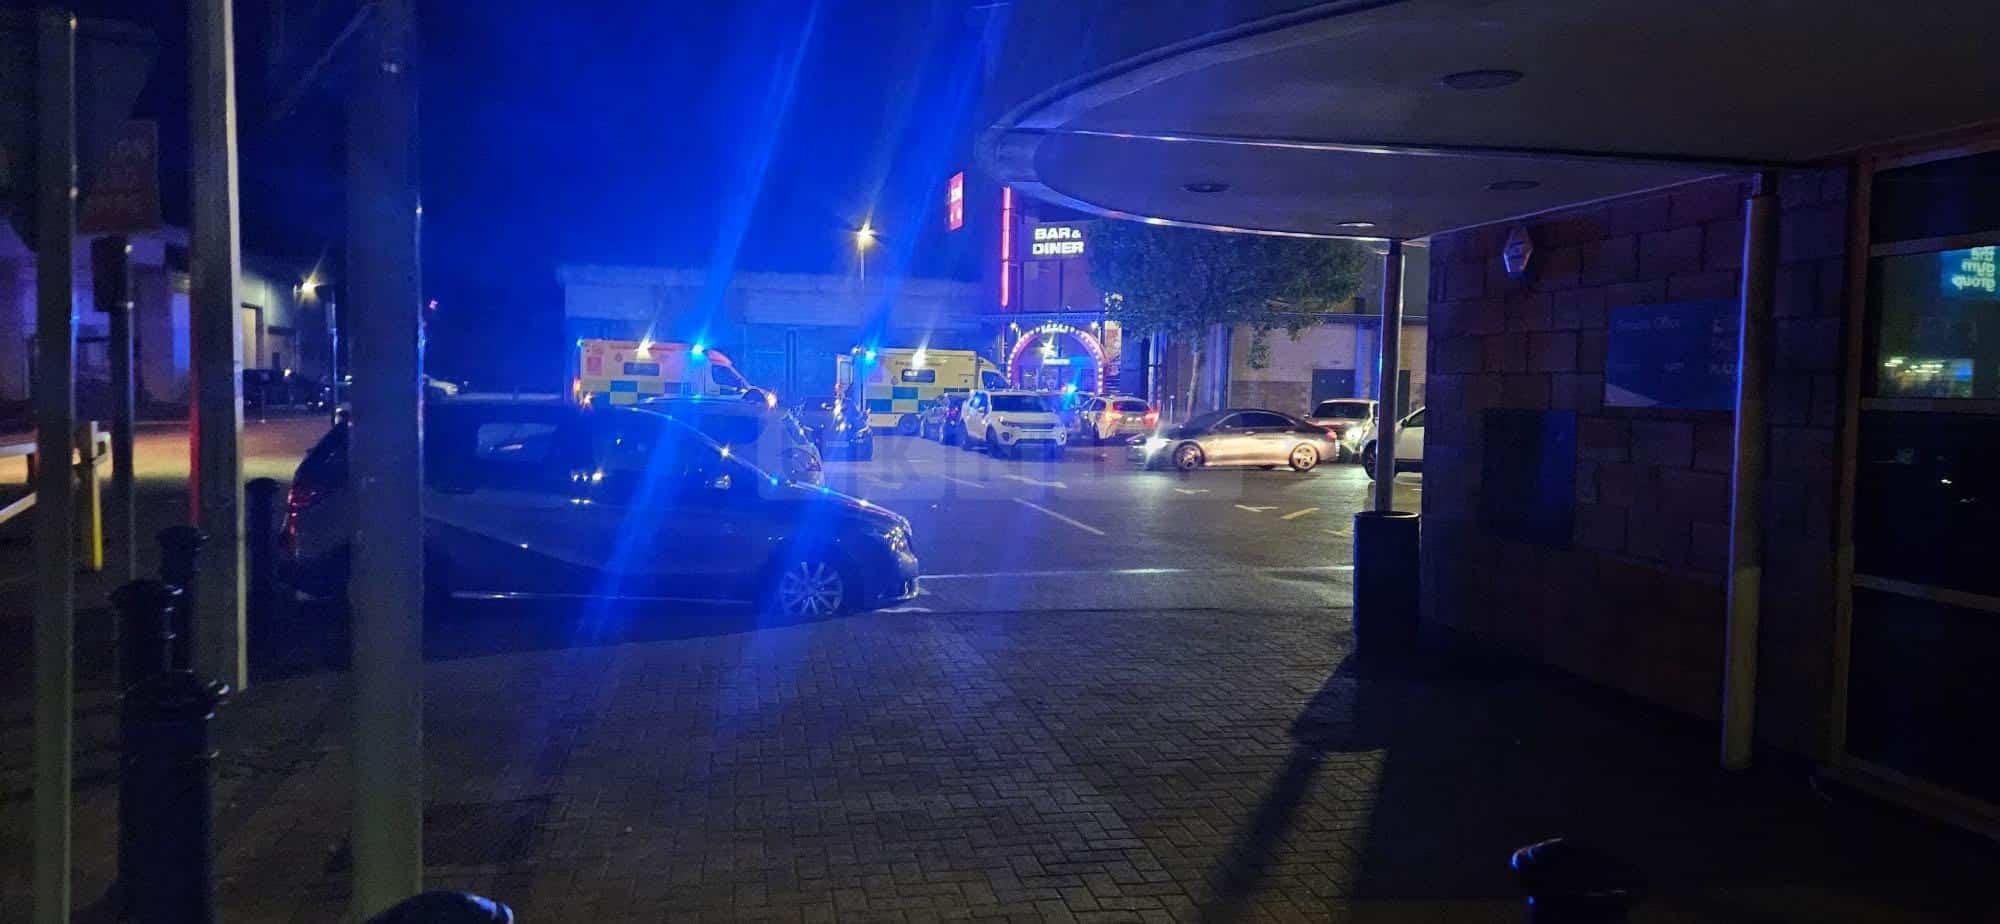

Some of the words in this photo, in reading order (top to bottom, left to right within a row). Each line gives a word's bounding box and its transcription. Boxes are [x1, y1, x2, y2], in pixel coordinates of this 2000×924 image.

[1035, 227, 1071, 240] BAR
[1071, 229, 1082, 239] &
[1032, 242, 1084, 255] DINER
